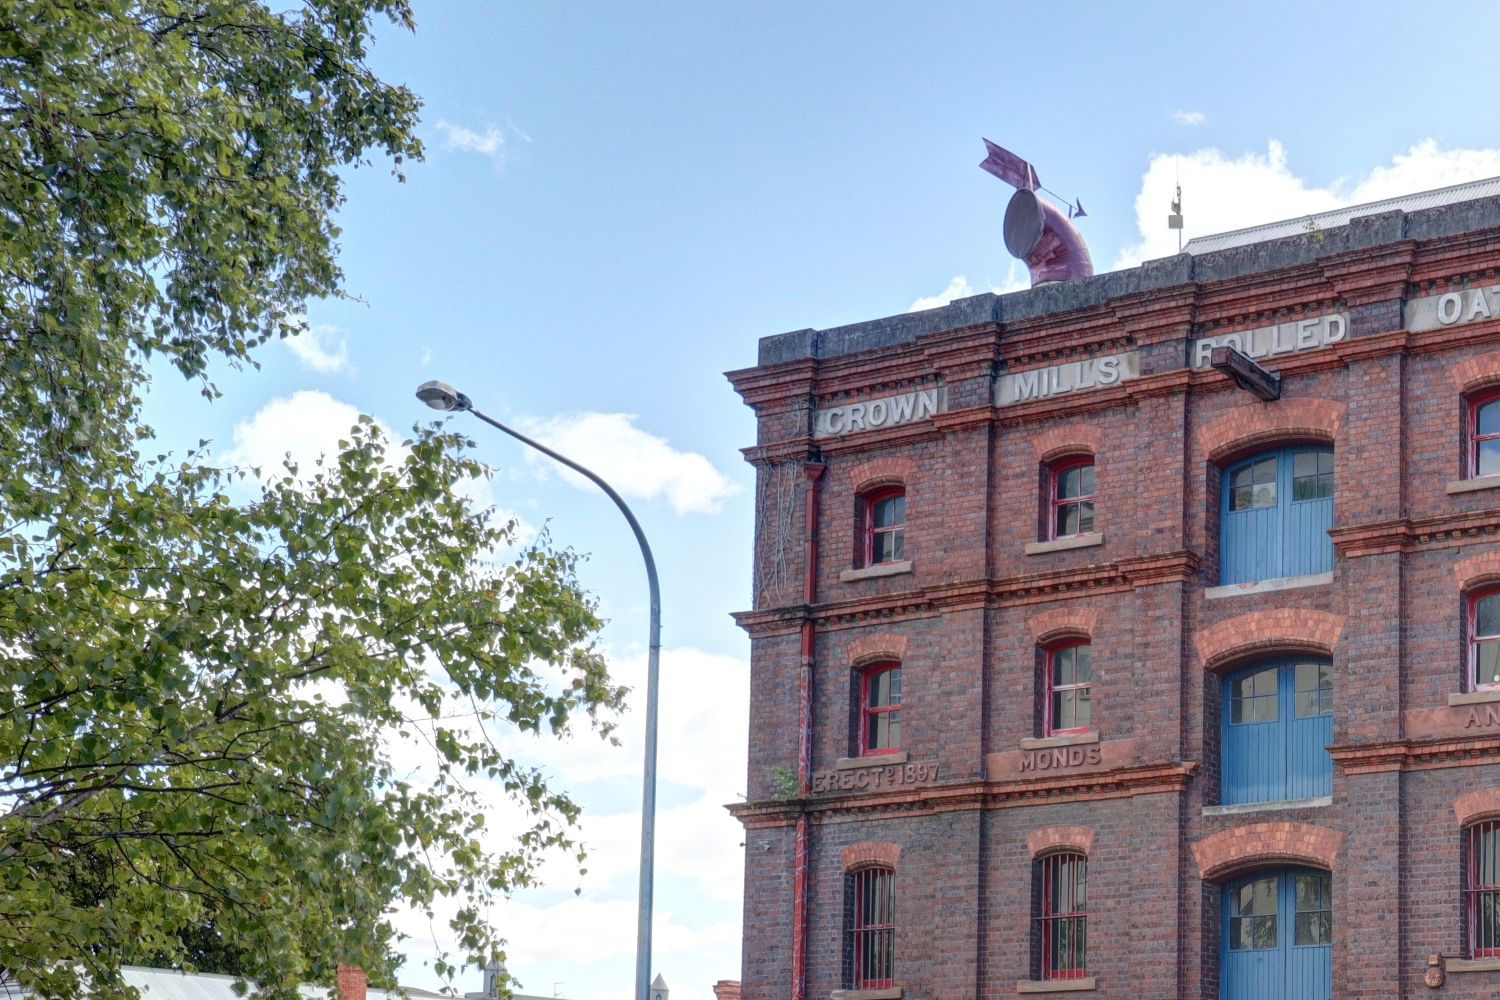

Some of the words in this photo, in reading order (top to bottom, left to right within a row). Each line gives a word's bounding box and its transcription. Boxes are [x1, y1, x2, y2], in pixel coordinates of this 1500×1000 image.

[825, 388, 940, 436] CROWN
[1013, 354, 1120, 402] MILLS
[1018, 746, 1101, 773] MONDS
[899, 763, 940, 786] 1897
